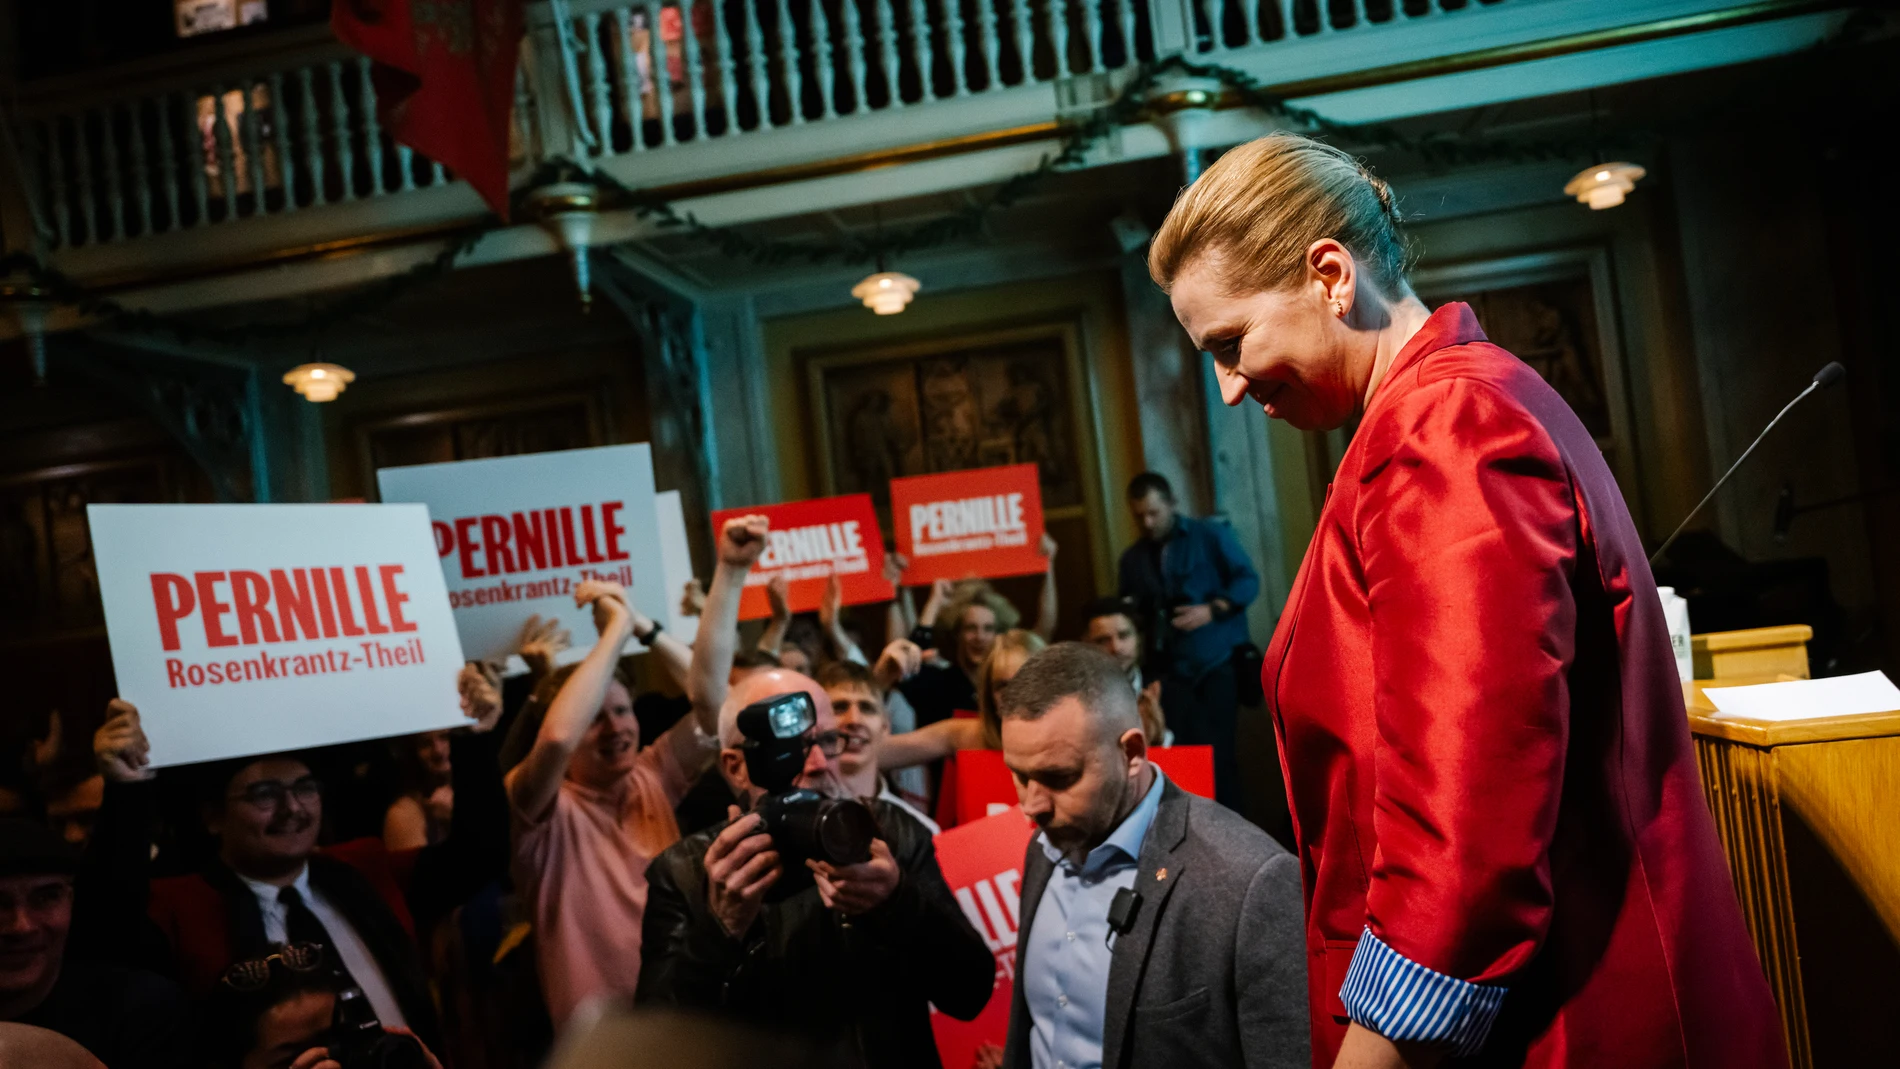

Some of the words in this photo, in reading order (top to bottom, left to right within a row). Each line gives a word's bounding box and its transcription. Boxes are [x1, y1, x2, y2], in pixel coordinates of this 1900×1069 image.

[909, 492, 1026, 545] PERNILLE
[758, 520, 866, 568] ERNILLE
[149, 564, 418, 652] PERNILLE
[450, 565, 633, 609] osenkrantz-Theil
[165, 638, 425, 688] Rosenkrantz-Theil
